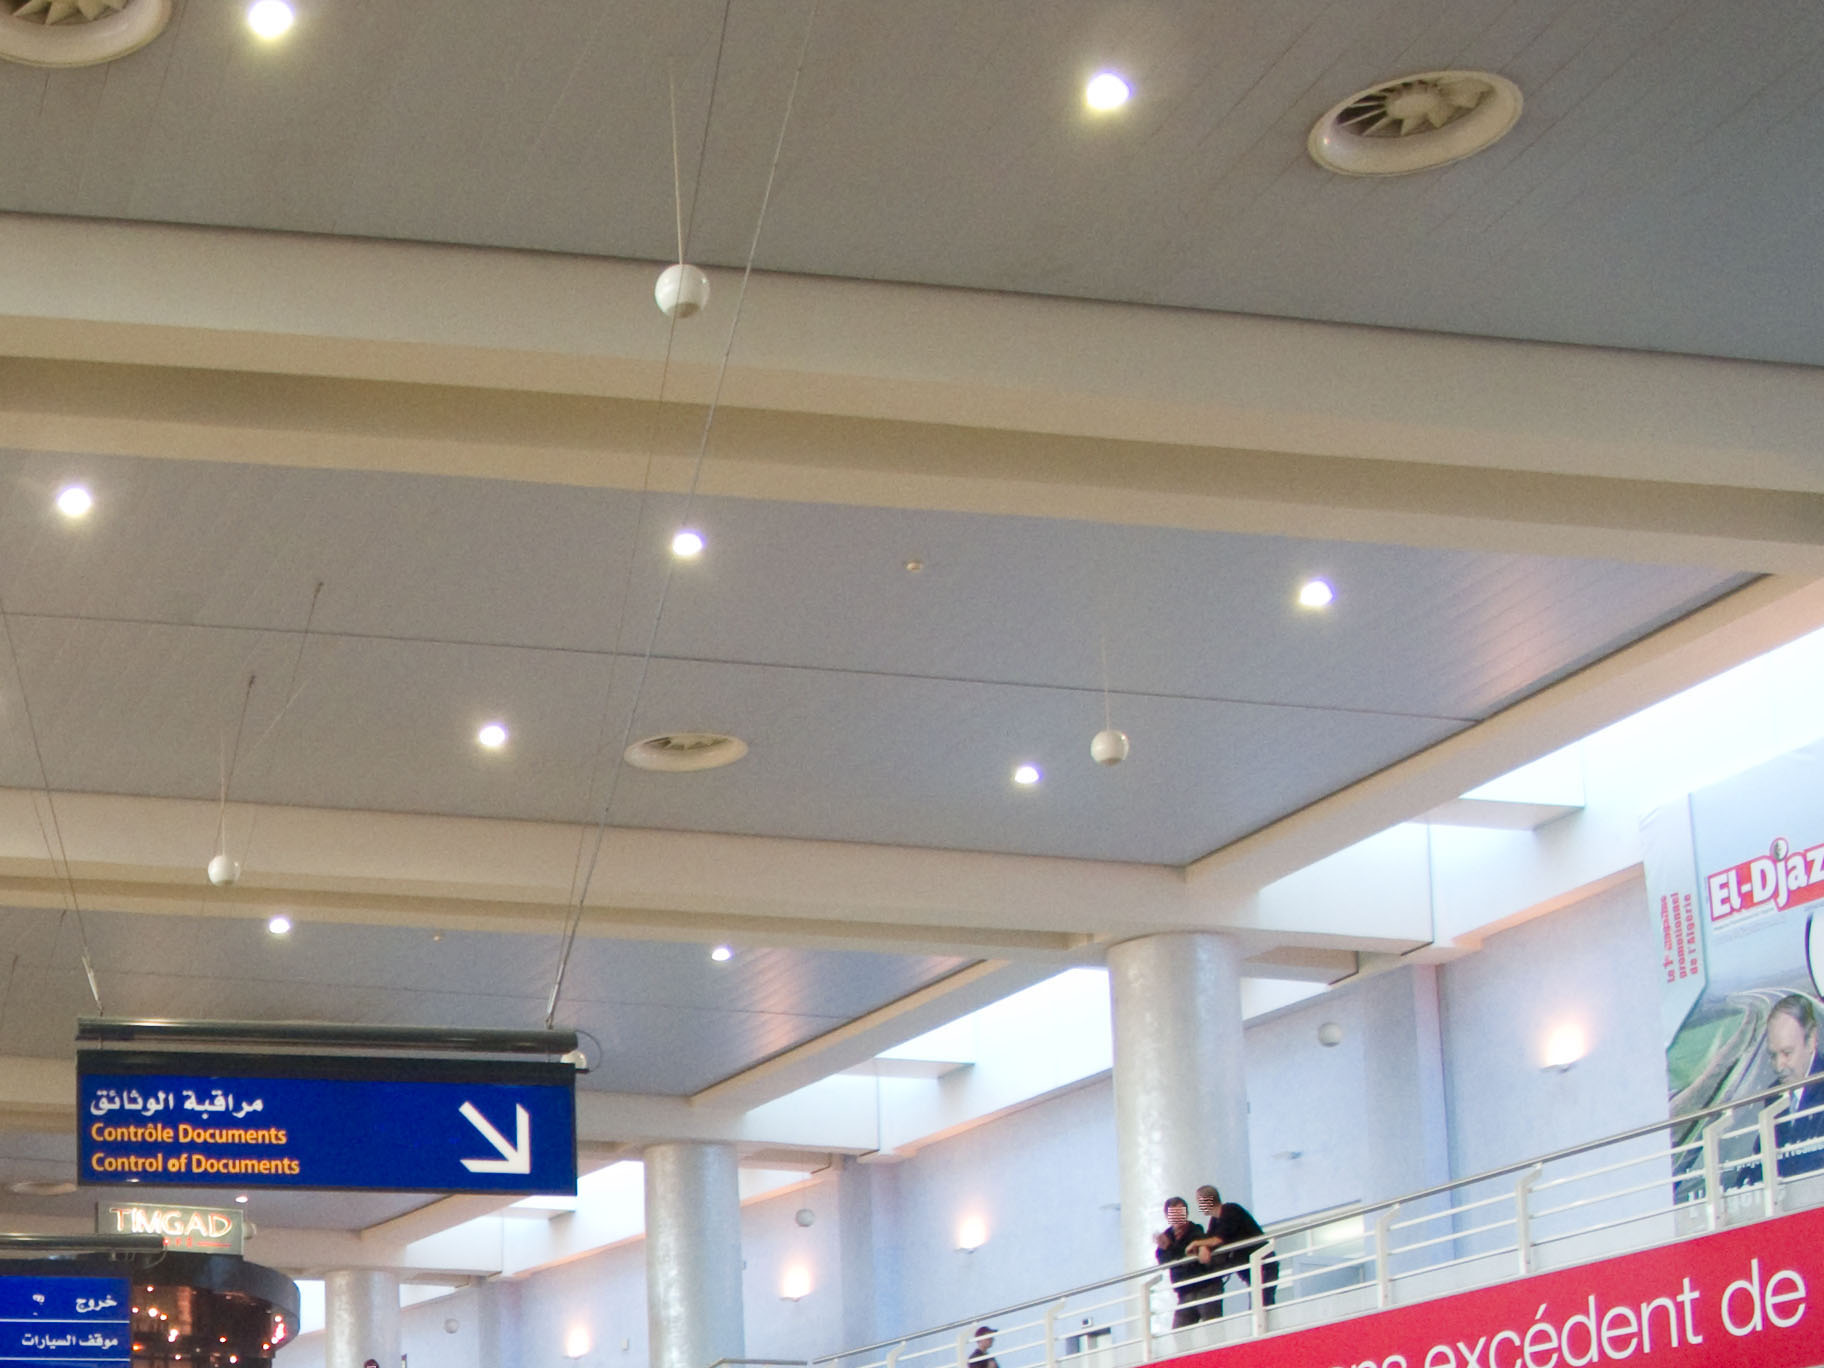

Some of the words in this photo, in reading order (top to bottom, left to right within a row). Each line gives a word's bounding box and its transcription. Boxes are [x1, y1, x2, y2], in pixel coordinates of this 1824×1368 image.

[90, 1089, 174, 1116] الوثائق
[183, 1089, 264, 1120] مراقبة
[91, 1122, 174, 1142] Contrôle
[178, 1124, 288, 1144] Documents
[91, 1152, 163, 1172] Control
[167, 1154, 188, 1173] of
[192, 1154, 300, 1174] Documents
[109, 1207, 233, 1238] TIMGAD
[75, 1293, 118, 1313] خروج
[1720, 1258, 1807, 1338] de
[21, 1333, 76, 1350] السيارات
[79, 1333, 119, 1350] موقف
